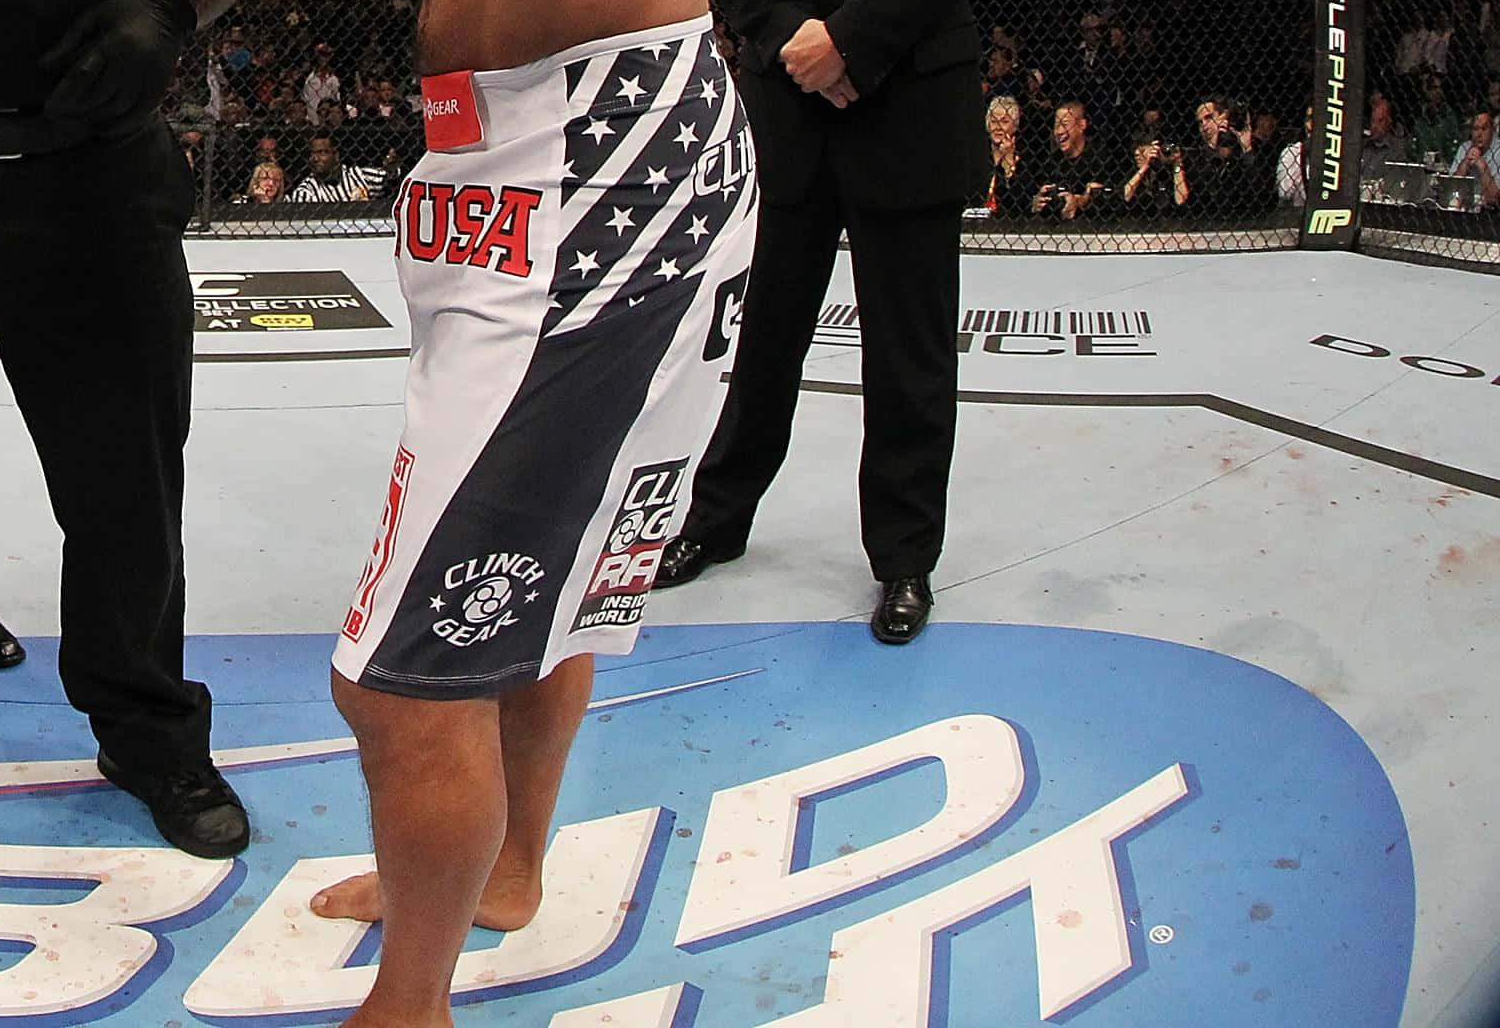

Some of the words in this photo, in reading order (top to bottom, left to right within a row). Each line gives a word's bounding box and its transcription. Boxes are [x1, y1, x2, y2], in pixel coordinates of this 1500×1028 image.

[433, 99, 460, 116] GEAR
[406, 180, 544, 278] USA
[208, 319, 242, 329] AT
[444, 552, 545, 590] CLINCH
[432, 609, 520, 647] GEAR
[580, 609, 639, 628] WORLD
